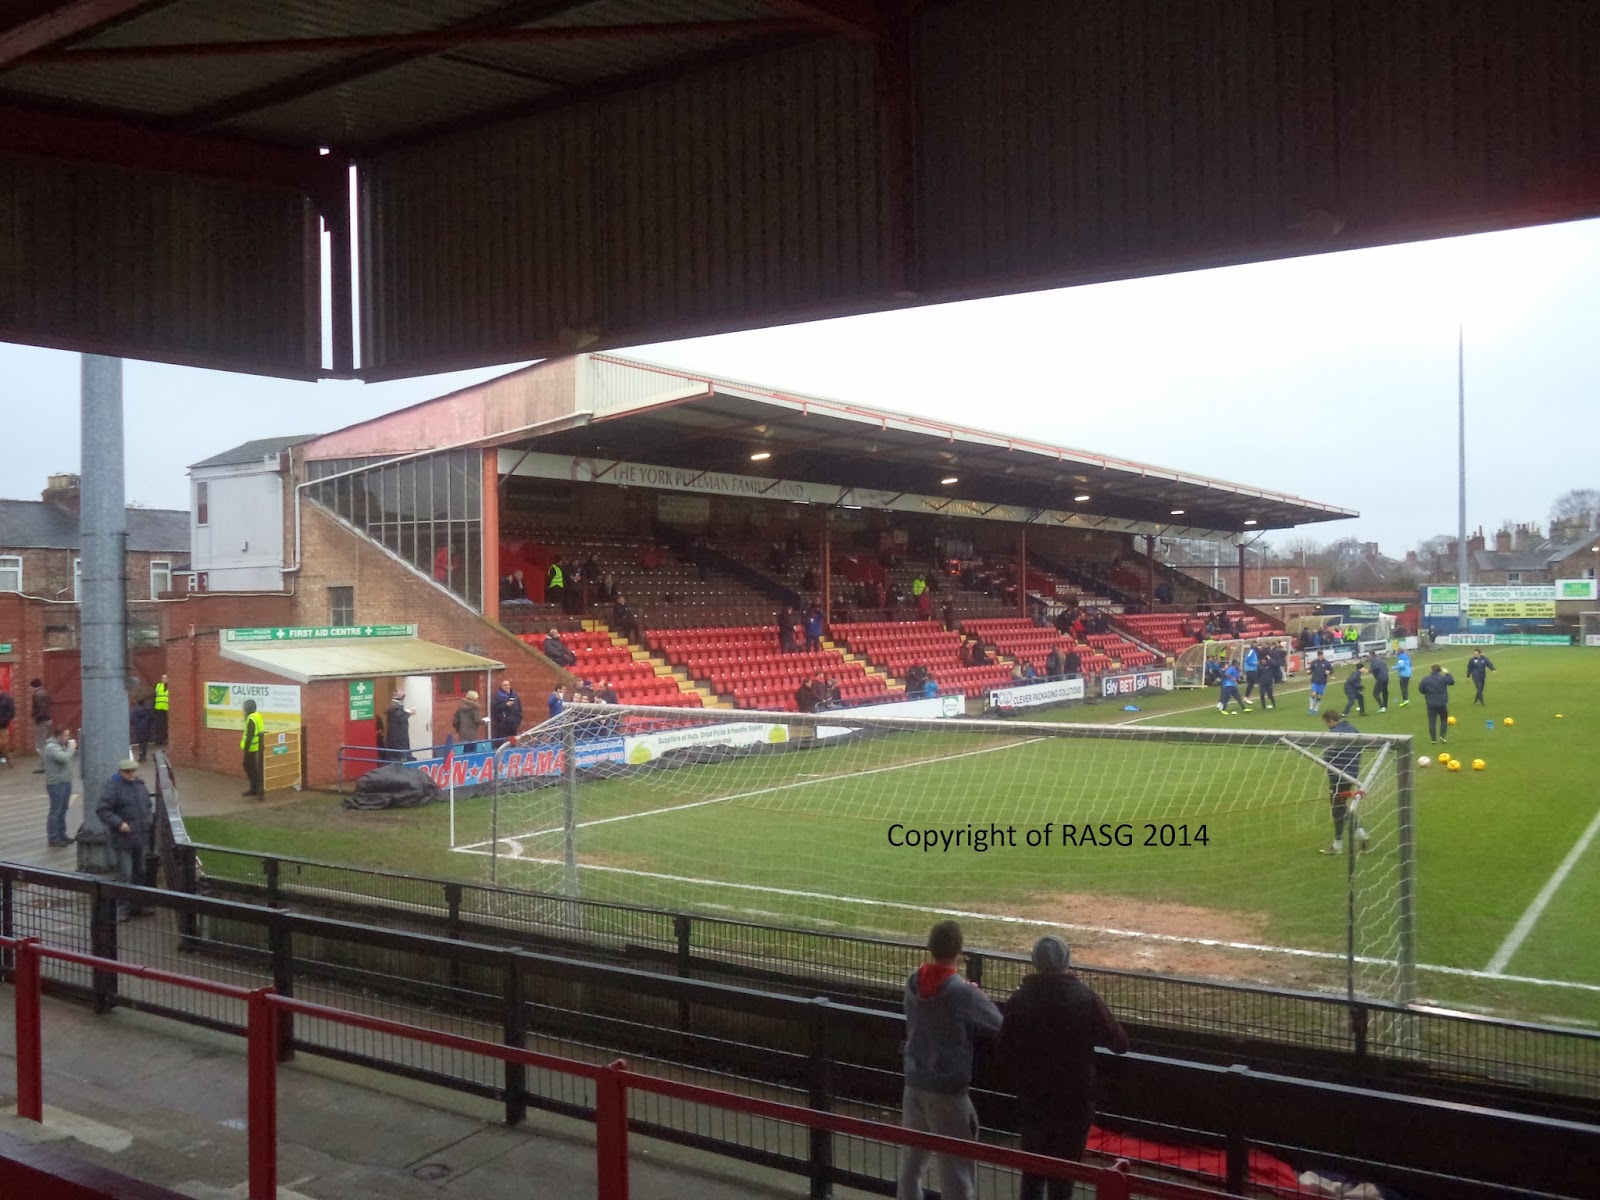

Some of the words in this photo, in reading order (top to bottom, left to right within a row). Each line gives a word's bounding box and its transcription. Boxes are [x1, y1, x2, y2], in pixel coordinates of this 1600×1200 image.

[613, 466, 636, 482] THE
[640, 468, 673, 486] YORK
[675, 472, 729, 491] PULLMAN
[771, 482, 805, 499] STAND
[289, 628, 313, 638] FIRST
[314, 628, 329, 637] AID
[330, 627, 361, 636] CENTRE
[232, 686, 270, 696] CALVERTS
[1119, 679, 1133, 693] BET
[1013, 694, 1033, 705] CLEVER
[1033, 689, 1059, 701] PACKAGING
[479, 757, 494, 784] A
[507, 748, 565, 778] RAMA
